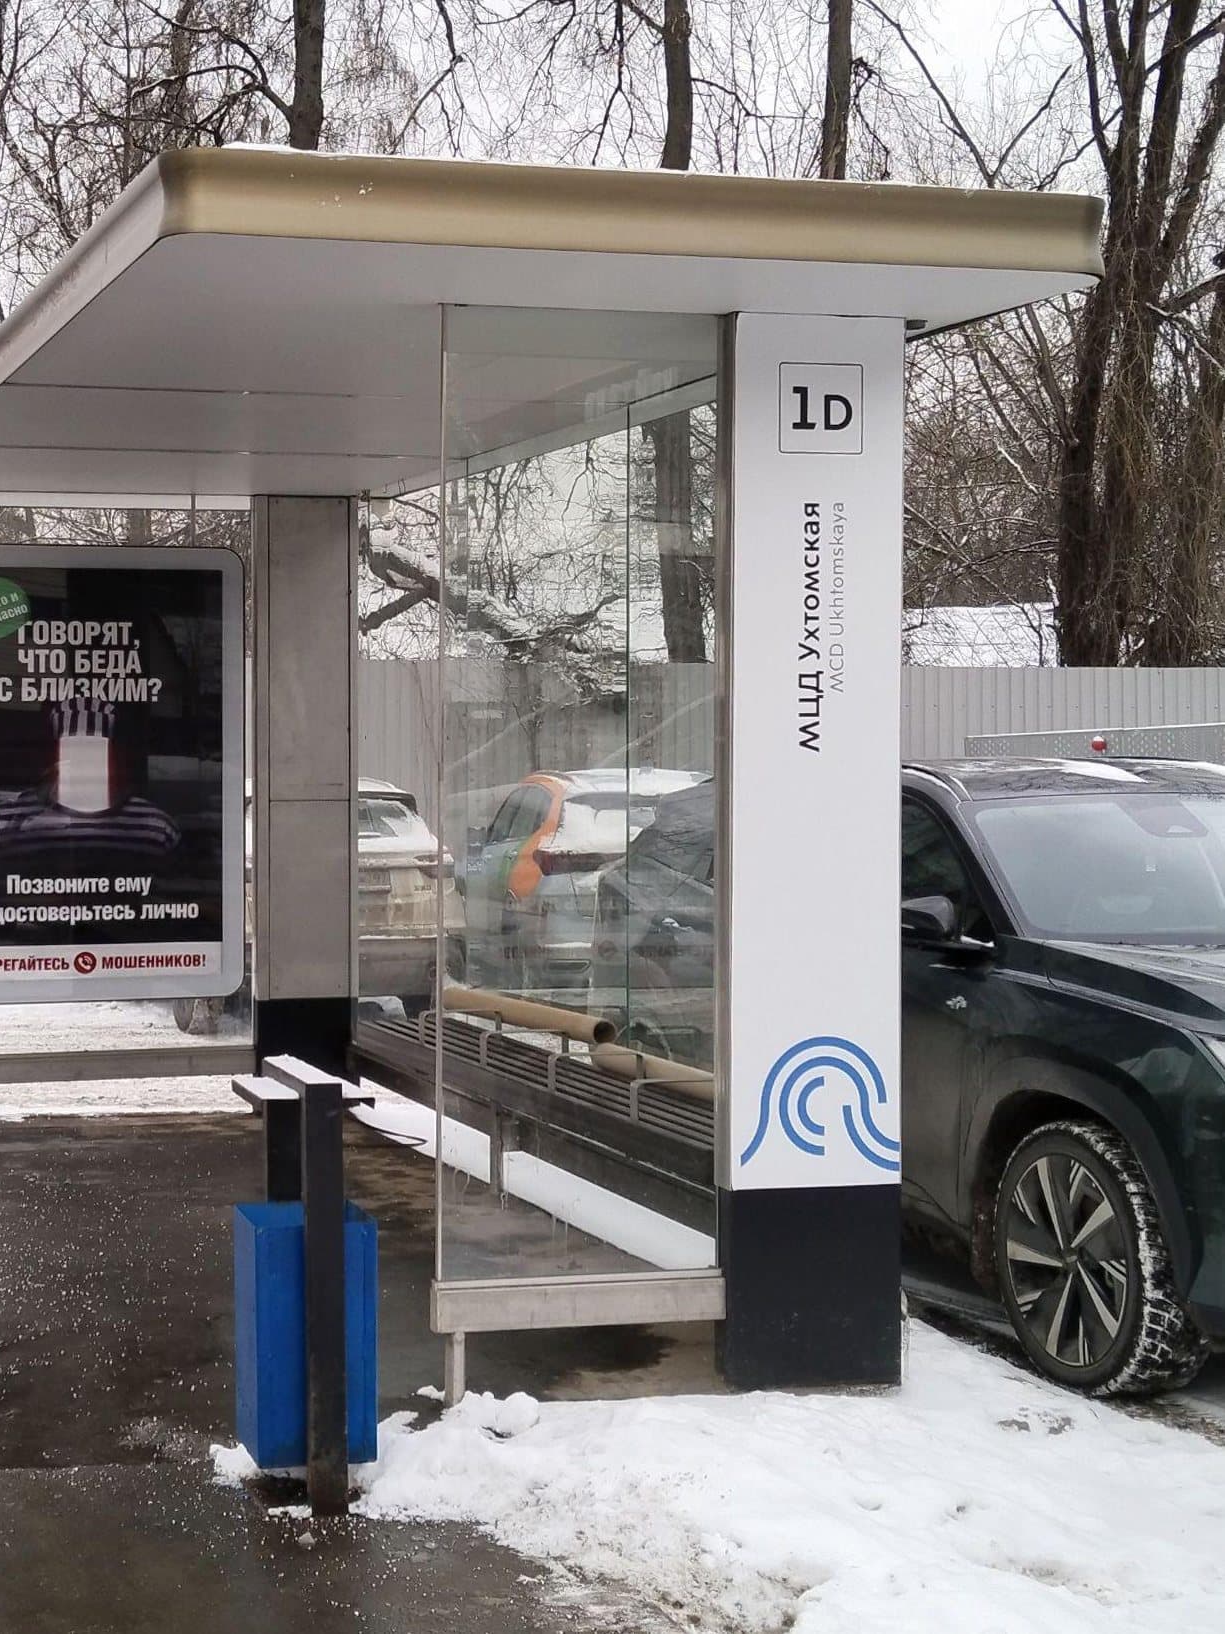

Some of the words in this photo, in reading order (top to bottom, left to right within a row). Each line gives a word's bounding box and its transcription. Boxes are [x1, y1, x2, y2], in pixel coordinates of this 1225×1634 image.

[791, 385, 854, 431] 1D
[798, 502, 821, 660] Ухтомская
[829, 501, 846, 635] Ukhtomskaya
[8, 592, 20, 604] и
[17, 620, 140, 649] ГОВОРЯТ,
[18, 648, 65, 674] ЧТО
[74, 650, 142, 678] БЕДА
[829, 643, 845, 692] MCD
[20, 675, 162, 702] БЛИЗКИМ?
[798, 670, 824, 752] МЦД
[6, 874, 110, 895] Позвоните
[114, 875, 151, 897] ему
[140, 903, 199, 920] лично
[101, 953, 206, 970] МОШЕННИКОВ!
